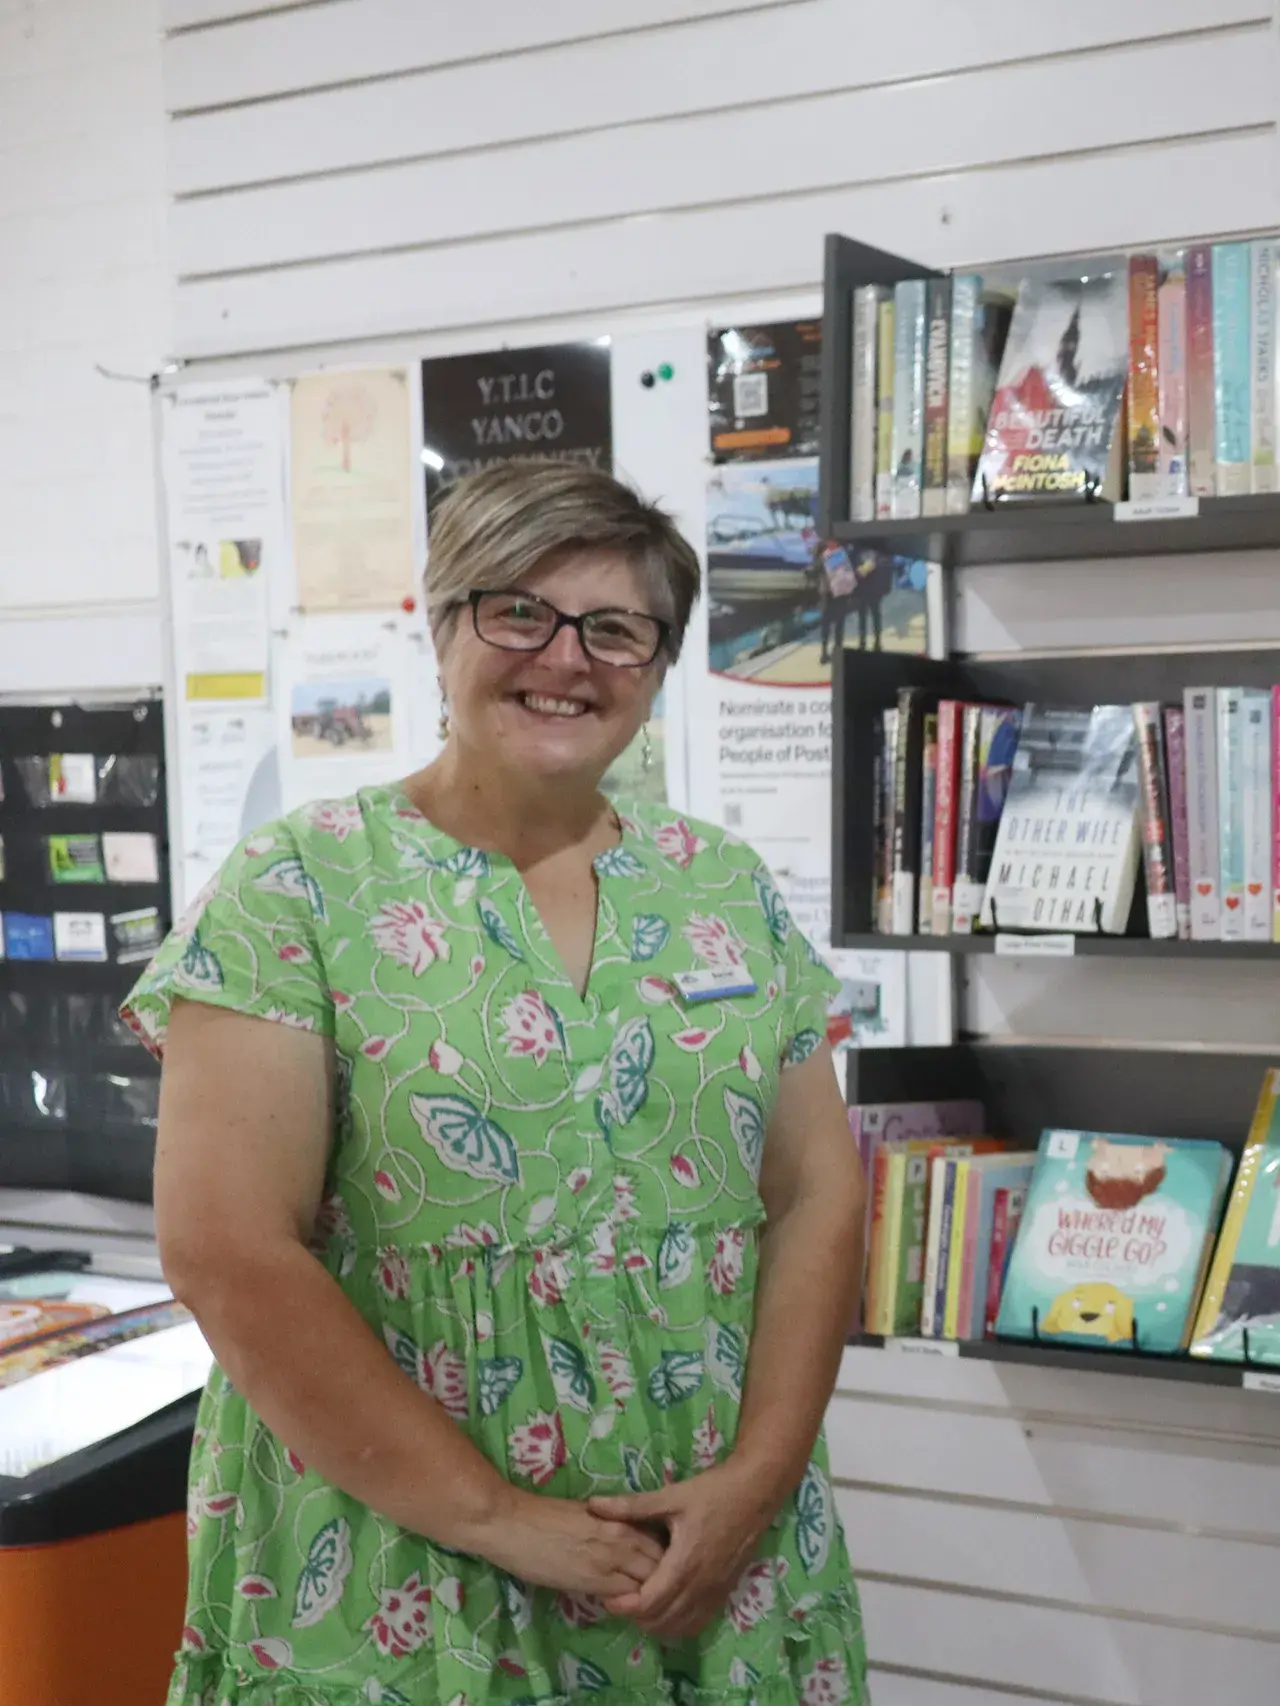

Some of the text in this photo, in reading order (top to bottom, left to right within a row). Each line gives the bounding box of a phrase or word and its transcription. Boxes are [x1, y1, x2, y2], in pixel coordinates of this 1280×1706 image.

[471, 408, 564, 445] YANCO
[996, 404, 1106, 430] BEAUTIFUL
[1026, 427, 1102, 449] DEATH
[1012, 453, 1071, 472] FIONA
[989, 471, 1087, 493] McINTOSH
[719, 700, 794, 718] Nominate
[798, 702, 807, 716] a
[719, 721, 815, 742] organisation
[719, 746, 773, 766] People
[776, 744, 791, 761] of
[1008, 816, 1121, 844] OTHER WIFE
[998, 862, 1110, 892] MICHAEL
[1124, 1238, 1168, 1267] GO?
